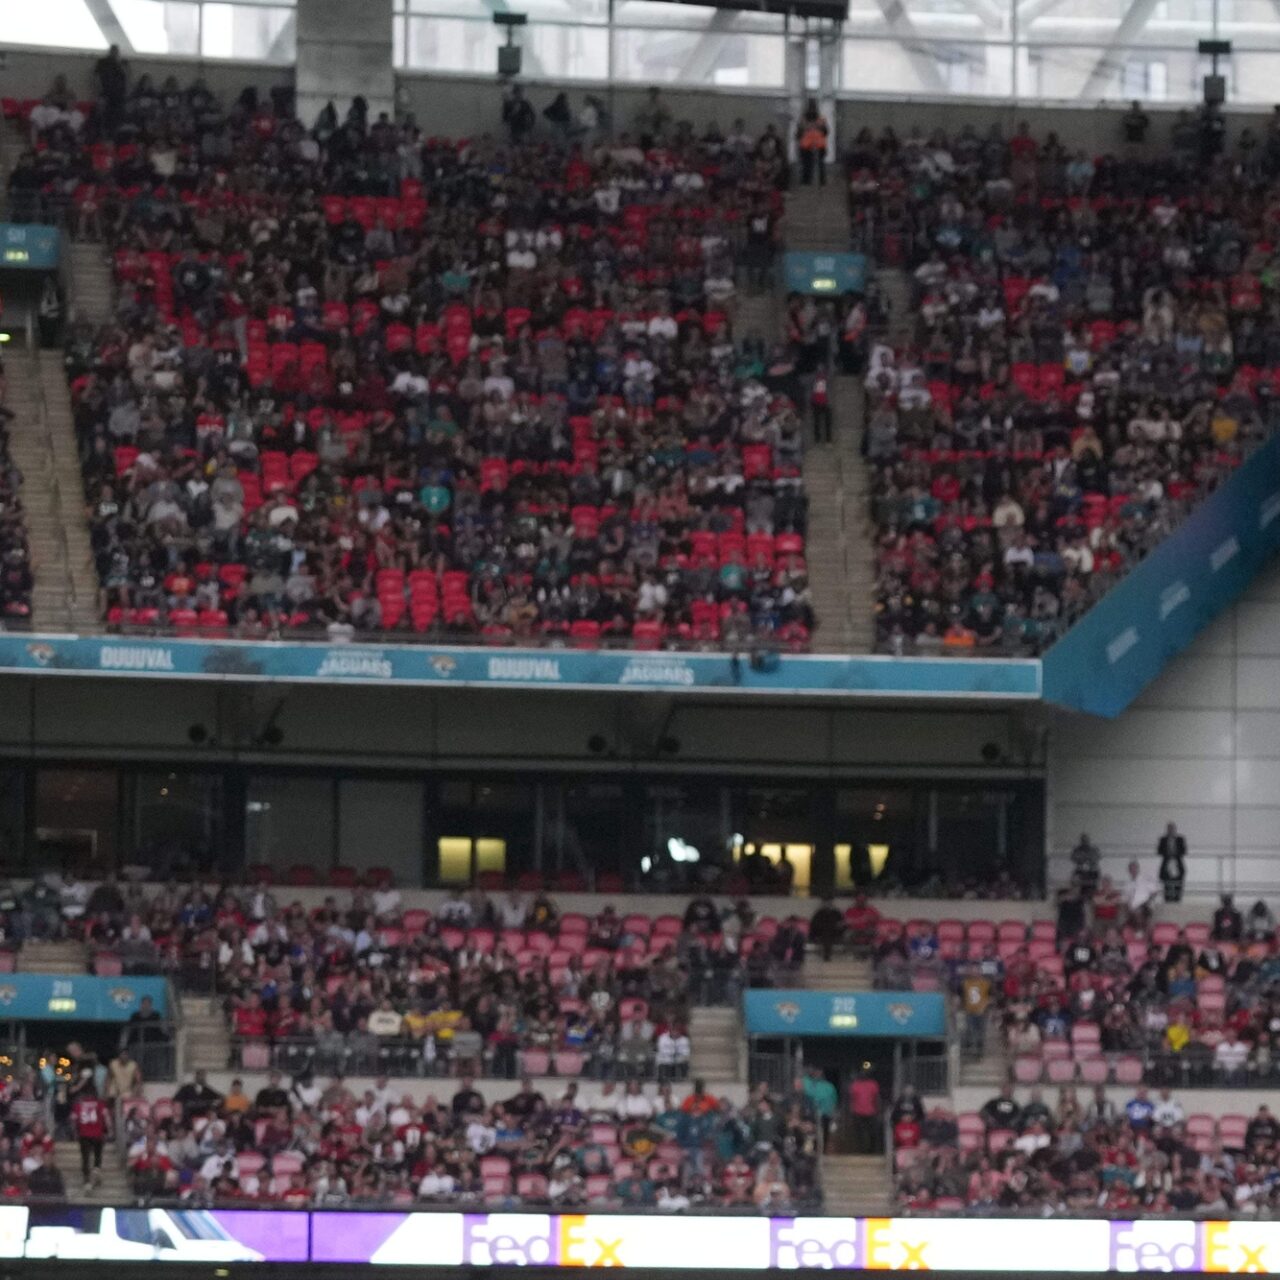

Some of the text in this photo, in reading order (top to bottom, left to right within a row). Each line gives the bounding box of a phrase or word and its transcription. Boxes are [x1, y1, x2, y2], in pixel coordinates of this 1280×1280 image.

[463, 1213, 625, 1267] FedEx
[769, 1217, 931, 1271] FedEx
[1109, 1220, 1270, 1273] FedEx
